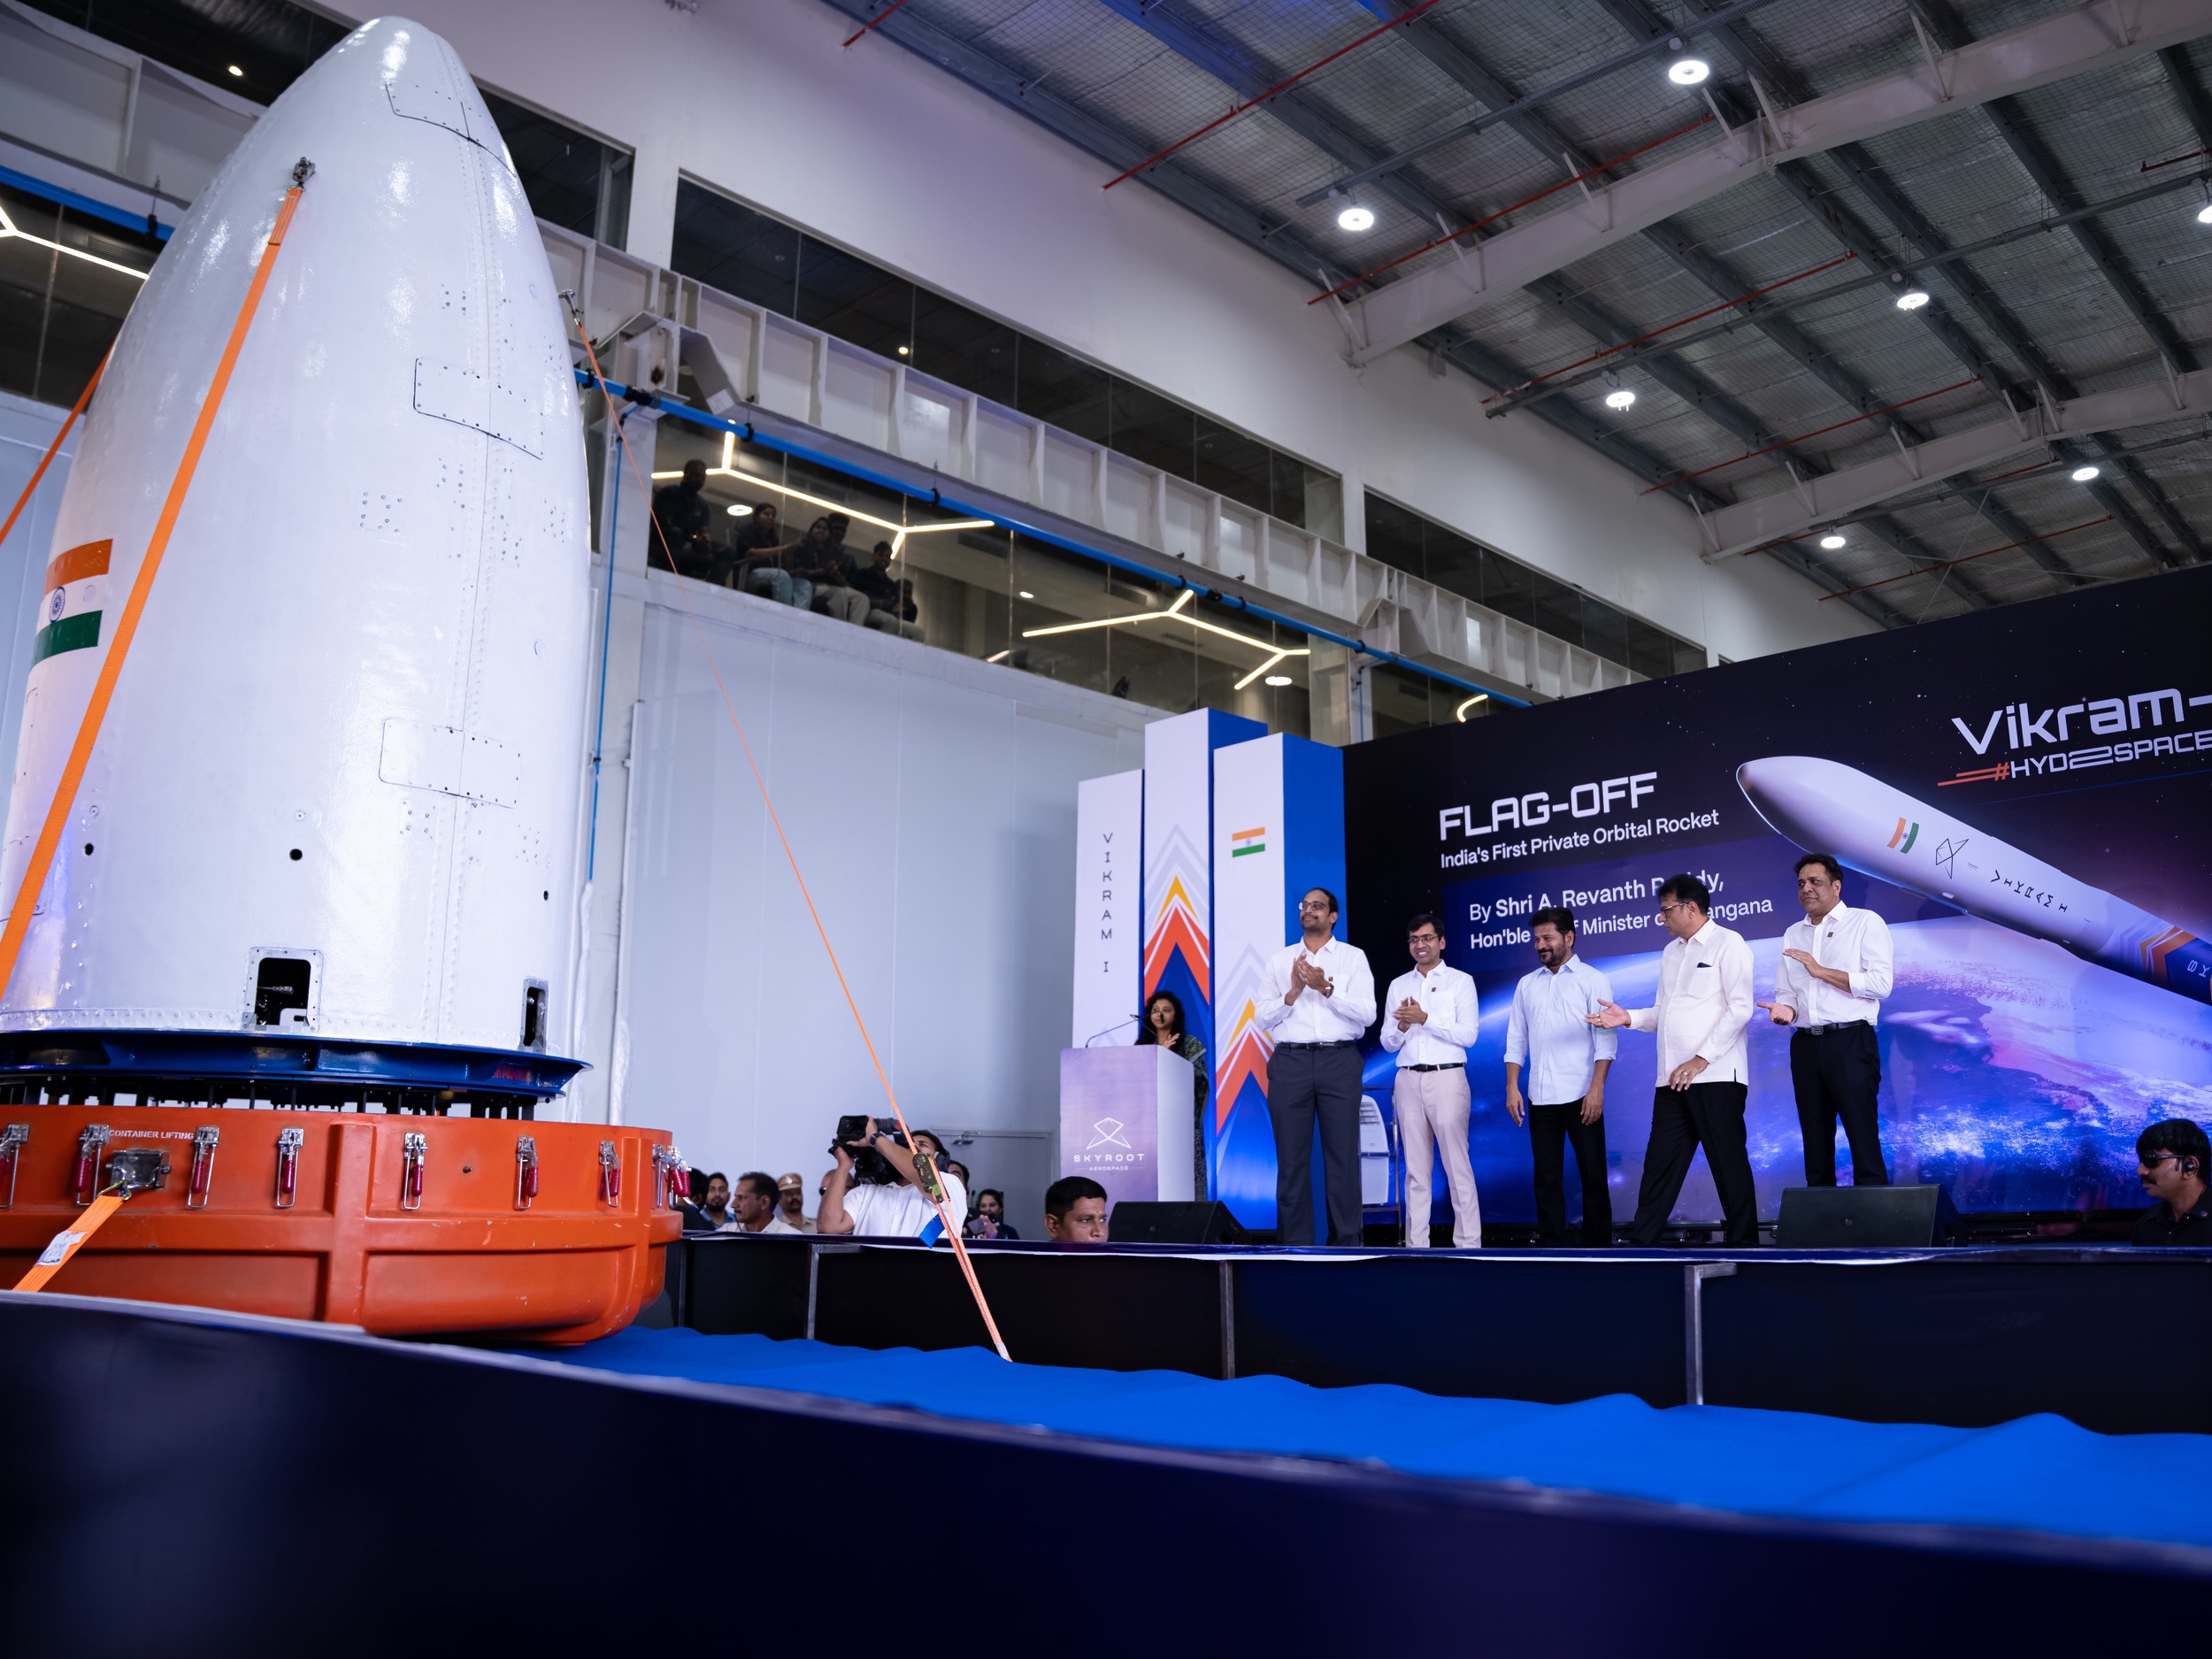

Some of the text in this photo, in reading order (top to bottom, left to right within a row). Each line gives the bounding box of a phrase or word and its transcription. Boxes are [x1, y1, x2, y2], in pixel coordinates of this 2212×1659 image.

[1440, 772, 1657, 841] FLAG-OFF
[1440, 809, 1720, 868] India's First Private Orbital Rocket
[1101, 832, 1113, 940] VIKRAM
[1470, 903, 1492, 924] By
[1495, 894, 1533, 918] Shri
[1538, 893, 1557, 910] A.
[1563, 879, 1646, 908] Revanth
[1470, 926, 1532, 949] Hon'ble
[1582, 913, 1651, 935] Minister
[1707, 899, 1773, 922] angana
[108, 1130, 159, 1139] CONTAINER
[1073, 1153, 1145, 1163] SKYROOT
